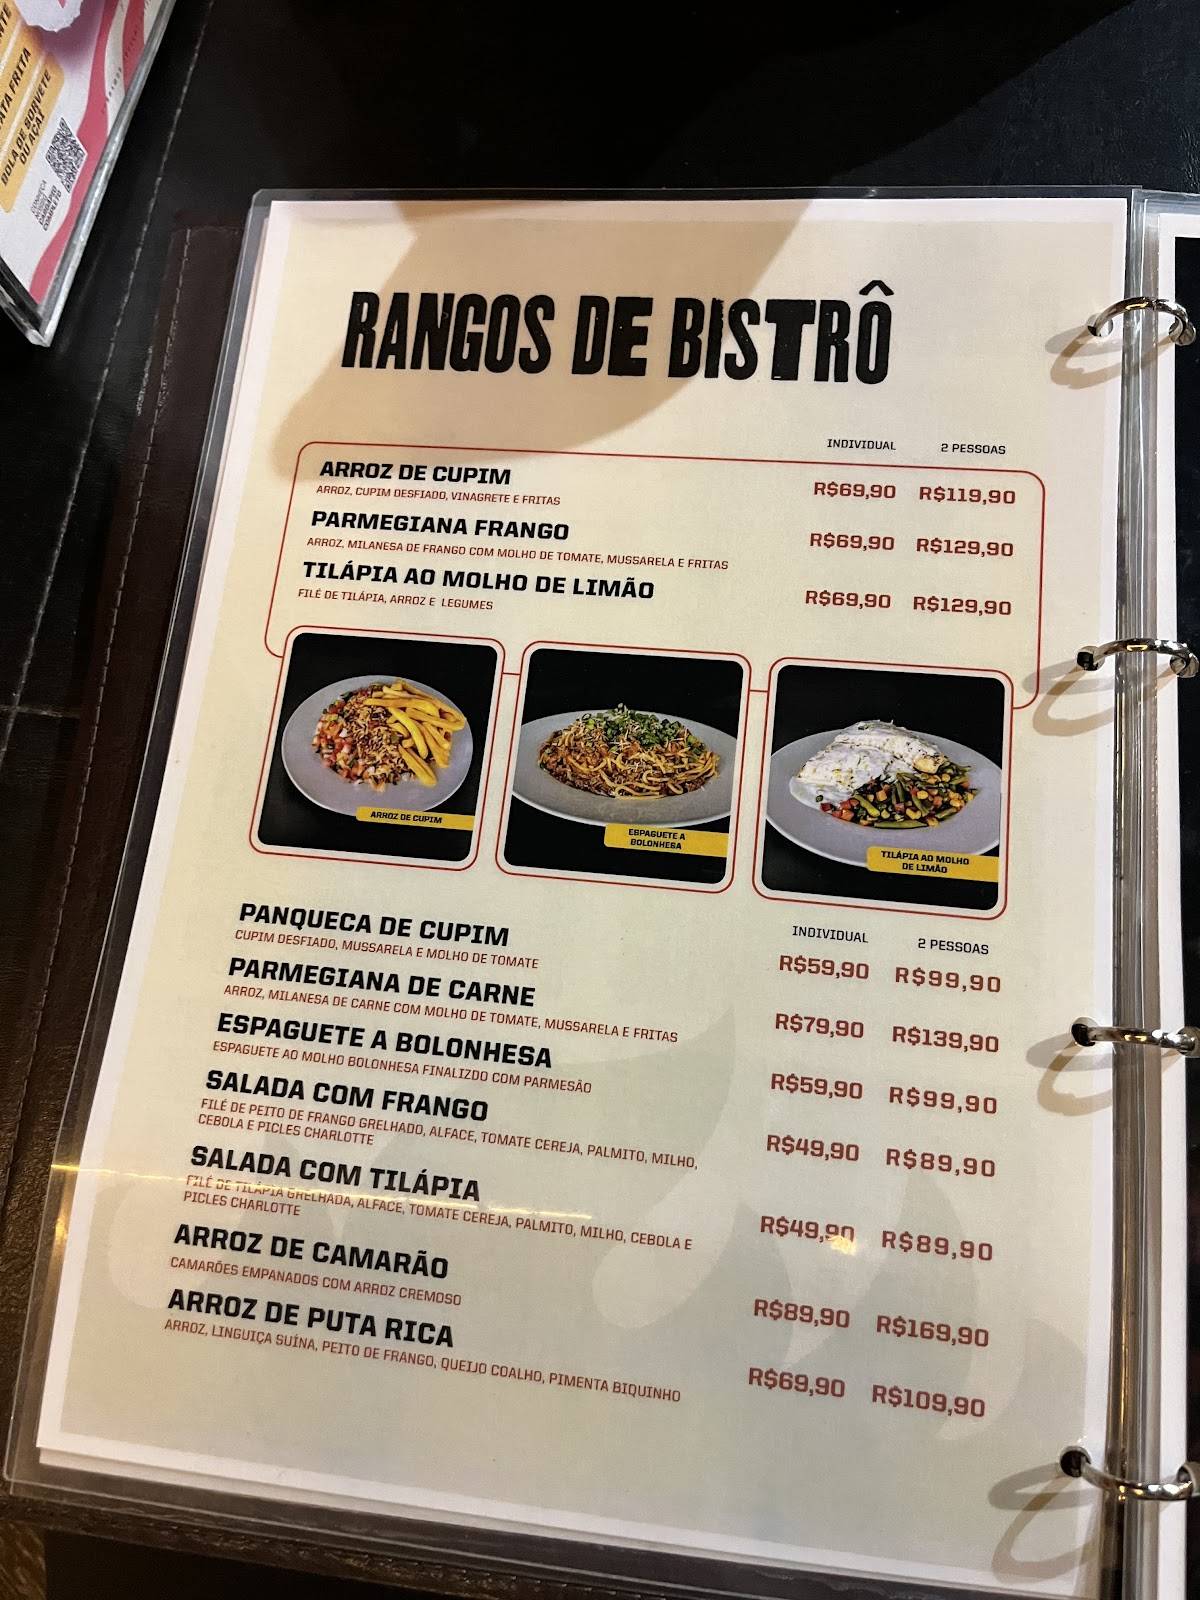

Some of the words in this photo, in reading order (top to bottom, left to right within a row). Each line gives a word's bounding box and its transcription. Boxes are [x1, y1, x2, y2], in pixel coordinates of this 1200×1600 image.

[0, 93, 13, 130] ATA
[9, 47, 31, 95] FRITA
[16, 127, 27, 149] DE
[24, 69, 51, 130] SORVETE
[19, 145, 31, 165] OU
[341, 291, 555, 374] RANGOS
[571, 295, 654, 377] DE
[667, 279, 893, 385] BISTRÔ
[827, 438, 896, 451] INDIVIDUAL
[941, 443, 949, 453] 2
[952, 443, 1006, 455] PESSOAS
[319, 461, 394, 479] ARROZ
[398, 464, 428, 481] DE
[432, 466, 511, 485] CUPIM
[316, 485, 353, 496] ARROZ,
[355, 487, 391, 497] CUPIM
[393, 489, 448, 501] DESFIADO,
[451, 491, 511, 503] VINAGRETE
[513, 494, 519, 504] E
[522, 495, 561, 506] FRITAS
[814, 481, 896, 500] R$69,90
[919, 486, 1016, 505] R$119,90
[311, 510, 468, 535] PARMEGIANA
[474, 519, 569, 540] FRANGO
[306, 537, 344, 548] ARROZ,
[347, 540, 403, 551] MILANESA
[406, 543, 420, 553] DE
[423, 544, 466, 555] FRANGO
[469, 547, 494, 557] COM
[497, 548, 537, 559] MOLHO
[539, 551, 554, 560] DE
[557, 551, 604, 564] TOMATE,
[607, 554, 675, 567] MUSSARELA
[678, 558, 685, 568] E
[687, 559, 729, 570] FRITAS
[810, 532, 895, 552] R$69,90
[916, 537, 1014, 558] R$129,90
[303, 560, 398, 583] TILÁPIA
[403, 568, 436, 585] AO
[442, 570, 528, 592] MOLHO
[535, 575, 567, 594] DE
[572, 577, 654, 599] LIMÃO
[298, 588, 321, 599] FILÉ
[324, 590, 338, 600] DE
[341, 590, 387, 604] TILÁPIA,
[389, 594, 426, 606] ARROZ
[429, 597, 436, 607] E
[441, 598, 493, 610] LEGUMES
[805, 589, 891, 610] R$69,90
[913, 595, 1011, 617] R$129,90
[370, 811, 398, 820] ARROZ
[400, 813, 411, 821] DE
[412, 815, 443, 824] CUPIM
[880, 850, 919, 861] TILÁPIA
[921, 854, 934, 862] AO
[936, 855, 970, 865] MOLHO
[902, 862, 914, 870] DE
[916, 864, 948, 873] LIMÃO
[239, 903, 371, 934] PANQUECA
[379, 916, 413, 938] DE
[419, 920, 509, 947] CUPIM
[792, 925, 868, 943] INDIVIDUAL
[235, 929, 275, 943] CUPIM
[277, 933, 338, 951] DESFIADO,
[342, 940, 413, 957] MUSSARELA
[416, 947, 424, 958] E
[426, 948, 469, 962] MOLHO
[472, 952, 488, 964] DE
[490, 954, 539, 969] TOMATE
[918, 938, 926, 949] 2
[930, 939, 989, 955] PESSOAS
[228, 957, 400, 993] PARMEGIANA
[407, 975, 442, 997] DE
[448, 979, 536, 1007] CARNE
[779, 955, 869, 980] R$59,90
[895, 967, 1001, 993] R$99,90
[223, 984, 265, 999] ARROZ,
[268, 989, 329, 1005] MILANESA
[332, 996, 348, 1007] DE
[350, 998, 391, 1012] CARNE
[393, 1002, 421, 1015] COM
[424, 1005, 467, 1020] MOLHO
[470, 1010, 487, 1022] DE
[490, 1012, 541, 1029] TOMATE,
[544, 1018, 619, 1036] MUSSARELA
[622, 1026, 630, 1037] E
[633, 1027, 678, 1043] FRITAS
[775, 1013, 864, 1039] R$79,90
[217, 1012, 365, 1048] ESPAGUETE
[370, 1030, 387, 1051] A
[395, 1032, 552, 1069] BOLONHESA
[892, 1026, 999, 1053] R$139,90
[213, 1040, 280, 1058] ESPAGUETE
[281, 1049, 299, 1060] AO
[301, 1051, 345, 1066] MOLHO
[347, 1056, 419, 1074] BOLONHESA
[422, 1064, 489, 1082] FINALIZDO
[492, 1072, 520, 1086] COM
[524, 1075, 592, 1094] PARMESÃO
[206, 1069, 305, 1100] SALADA
[312, 1082, 375, 1109] COM
[381, 1090, 488, 1122] FRANGO
[771, 1073, 863, 1100] R$59,90
[889, 1086, 997, 1114] R$99,90
[201, 1098, 227, 1112] FILÉ
[230, 1101, 246, 1114] DE
[248, 1104, 285, 1118] PEITO
[288, 1108, 304, 1121] DE
[307, 1111, 356, 1127] FRANGO
[358, 1117, 426, 1137] GRELHADO,
[429, 1126, 477, 1143] ALFACE,
[481, 1131, 531, 1148] TOMATE
[535, 1138, 583, 1156] CEREJA,
[587, 1144, 647, 1164] PALMITO,
[652, 1152, 698, 1170] MILHO,
[766, 1134, 860, 1162] R$49,90
[190, 1145, 291, 1178] SALADA
[299, 1159, 362, 1187] COM
[369, 1167, 480, 1202] TILÁPIA
[886, 1148, 995, 1178] R$89,90
[173, 1223, 263, 1254] ARROZ
[270, 1235, 305, 1260] DE
[312, 1241, 449, 1279] CAMARÃO
[882, 1230, 993, 1261] R$89,90
[170, 1256, 239, 1276] CAMARÕES
[241, 1265, 319, 1287] EMPANADOS
[322, 1276, 351, 1291] COM
[353, 1281, 396, 1297] ARROZ
[399, 1287, 462, 1306] CREMOSO
[167, 1288, 258, 1320] ARROZ
[264, 1301, 300, 1326] DE
[307, 1306, 377, 1337] PUTA
[384, 1317, 453, 1348] RICA
[754, 1298, 850, 1329] R$89,90
[876, 1315, 989, 1347] R$169,90
[164, 1319, 208, 1336] ARROZ,
[211, 1325, 272, 1345] LINGUIÇA
[275, 1334, 318, 1352] SUÍNA,
[322, 1340, 360, 1357] PEITO
[363, 1346, 380, 1360] DE
[383, 1349, 437, 1369] FRANGO,
[441, 1357, 487, 1375] QUEIJO
[491, 1364, 545, 1384] COALHO,
[549, 1372, 609, 1392] PIMENTA
[612, 1381, 681, 1402] BIQUINHO
[748, 1367, 845, 1398] R$69,90
[872, 1384, 985, 1418] R$109,90
